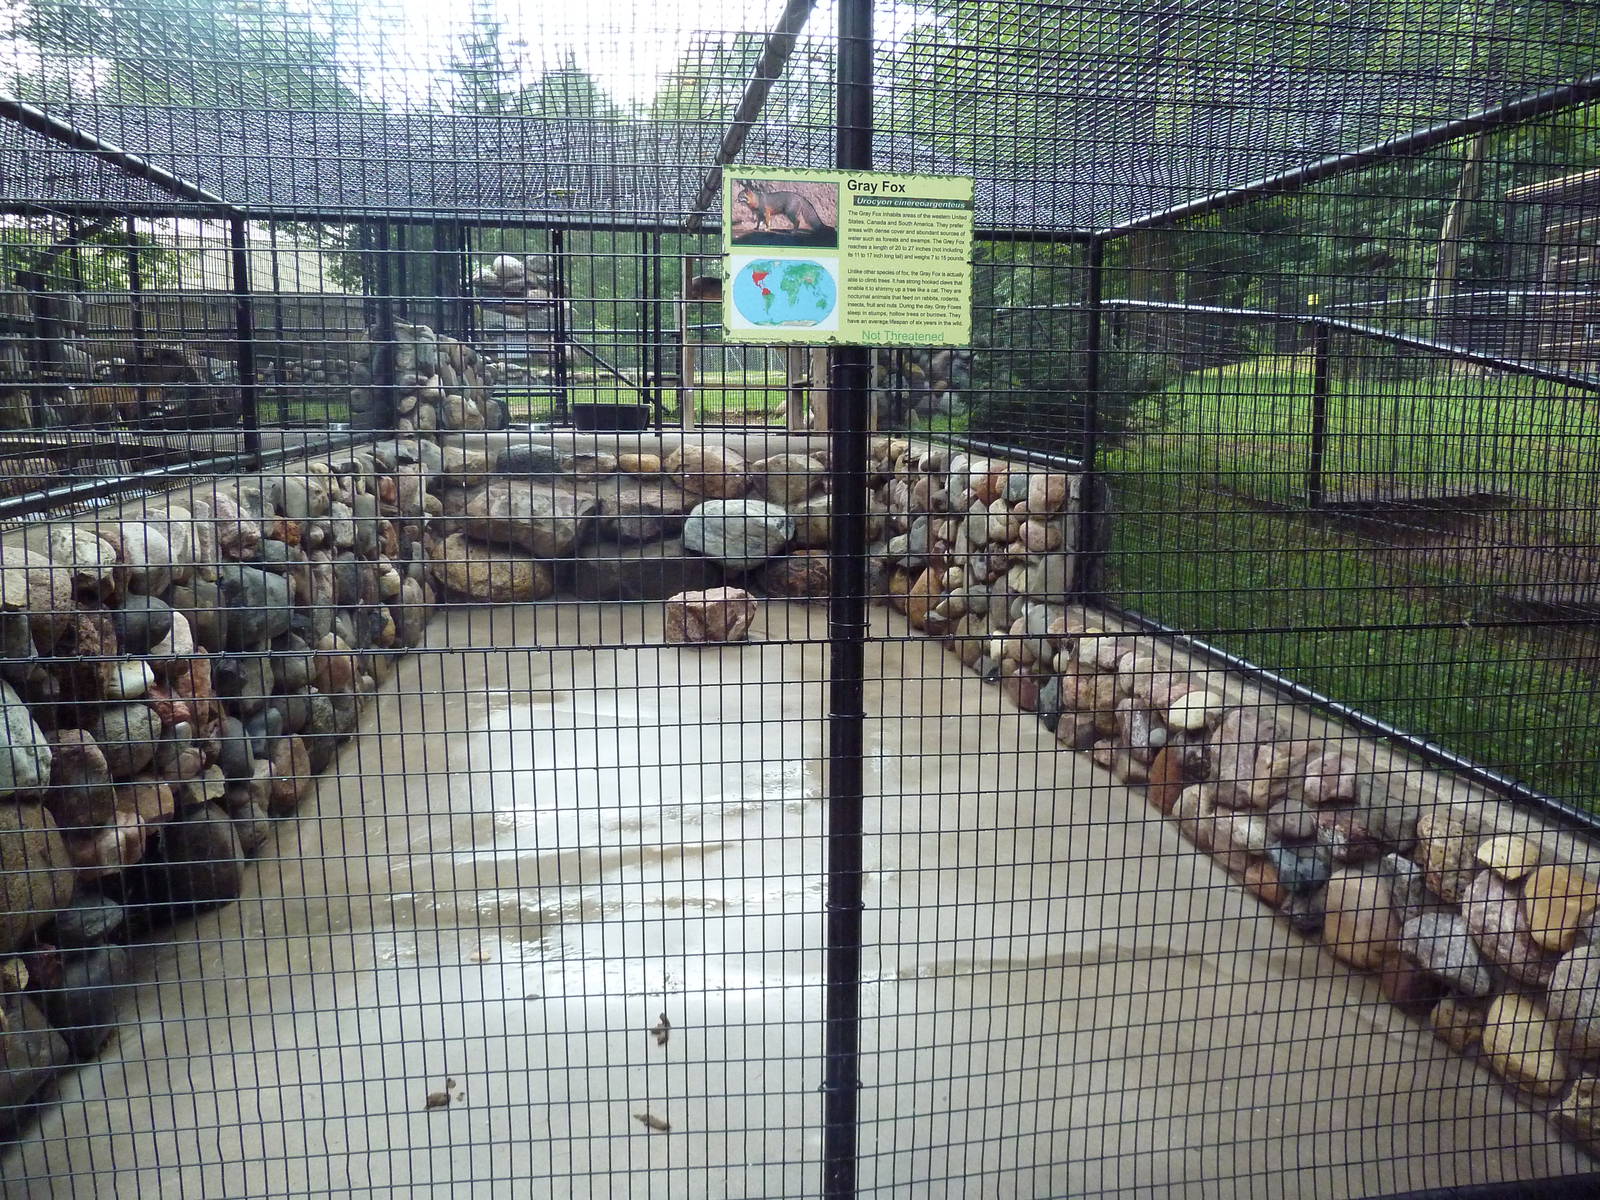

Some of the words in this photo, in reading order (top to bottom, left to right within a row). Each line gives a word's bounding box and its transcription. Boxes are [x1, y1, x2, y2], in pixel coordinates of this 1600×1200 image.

[848, 180, 877, 194] Gray
[883, 181, 905, 192] Fox
[857, 198, 892, 206] Urocyon
[894, 200, 965, 208] cinereoargenteus
[862, 330, 880, 340] Not
[884, 331, 944, 341] Threatened
